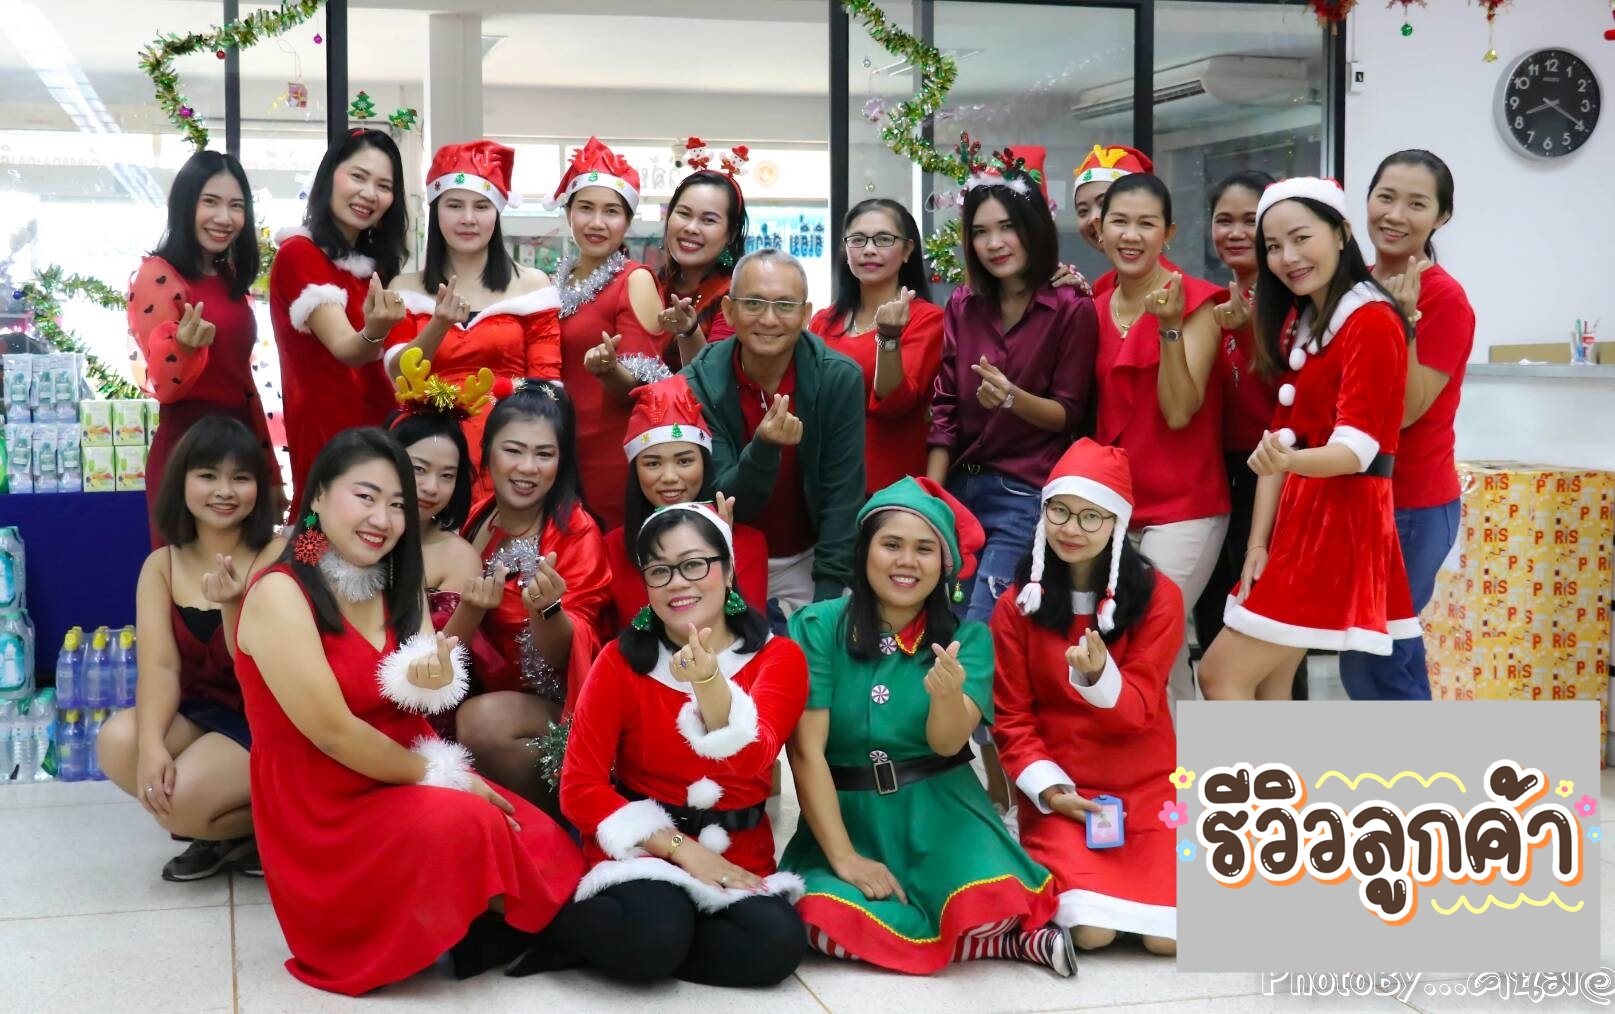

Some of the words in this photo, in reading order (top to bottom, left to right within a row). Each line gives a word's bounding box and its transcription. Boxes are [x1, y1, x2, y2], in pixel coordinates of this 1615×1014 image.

[1528, 64, 1539, 76] 11
[1544, 58, 1559, 72] 12
[1566, 66, 1572, 78] 1
[1514, 77, 1530, 90] 10
[1577, 80, 1587, 92] 2
[1509, 97, 1520, 110] 9
[1580, 100, 1590, 112] 3
[1514, 116, 1524, 129] 8
[1574, 120, 1584, 131] 4
[1526, 131, 1535, 143] 7
[1562, 132, 1571, 145] 5
[1543, 137, 1553, 150] 6
